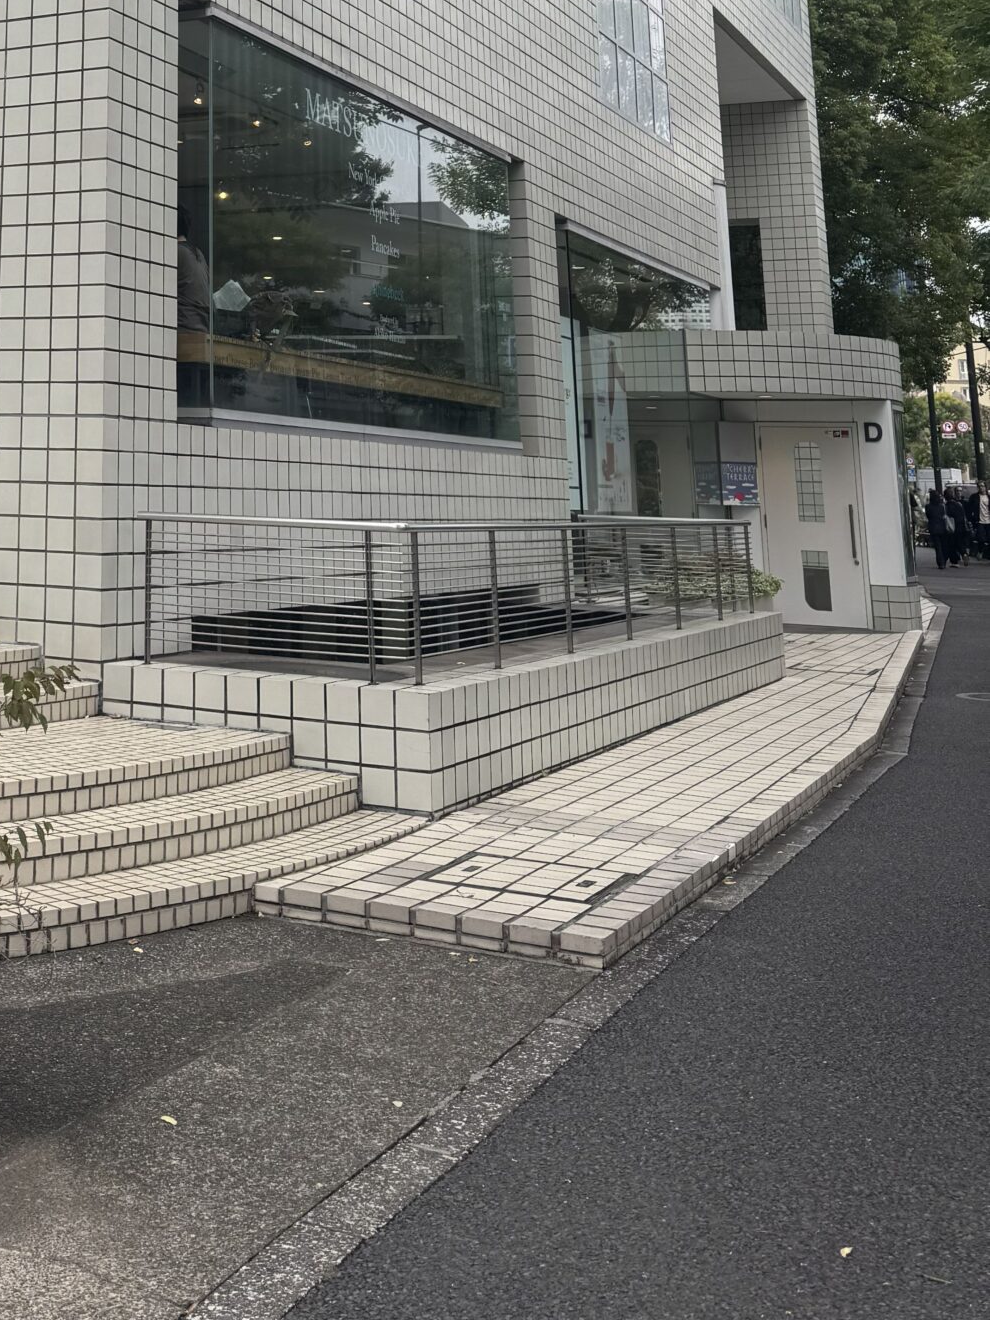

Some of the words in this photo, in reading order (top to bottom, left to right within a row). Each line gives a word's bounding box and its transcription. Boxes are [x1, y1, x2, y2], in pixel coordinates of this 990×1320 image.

[371, 234, 401, 259] Pancakes
[863, 422, 883, 443] D
[726, 472, 755, 482] TERRACE
